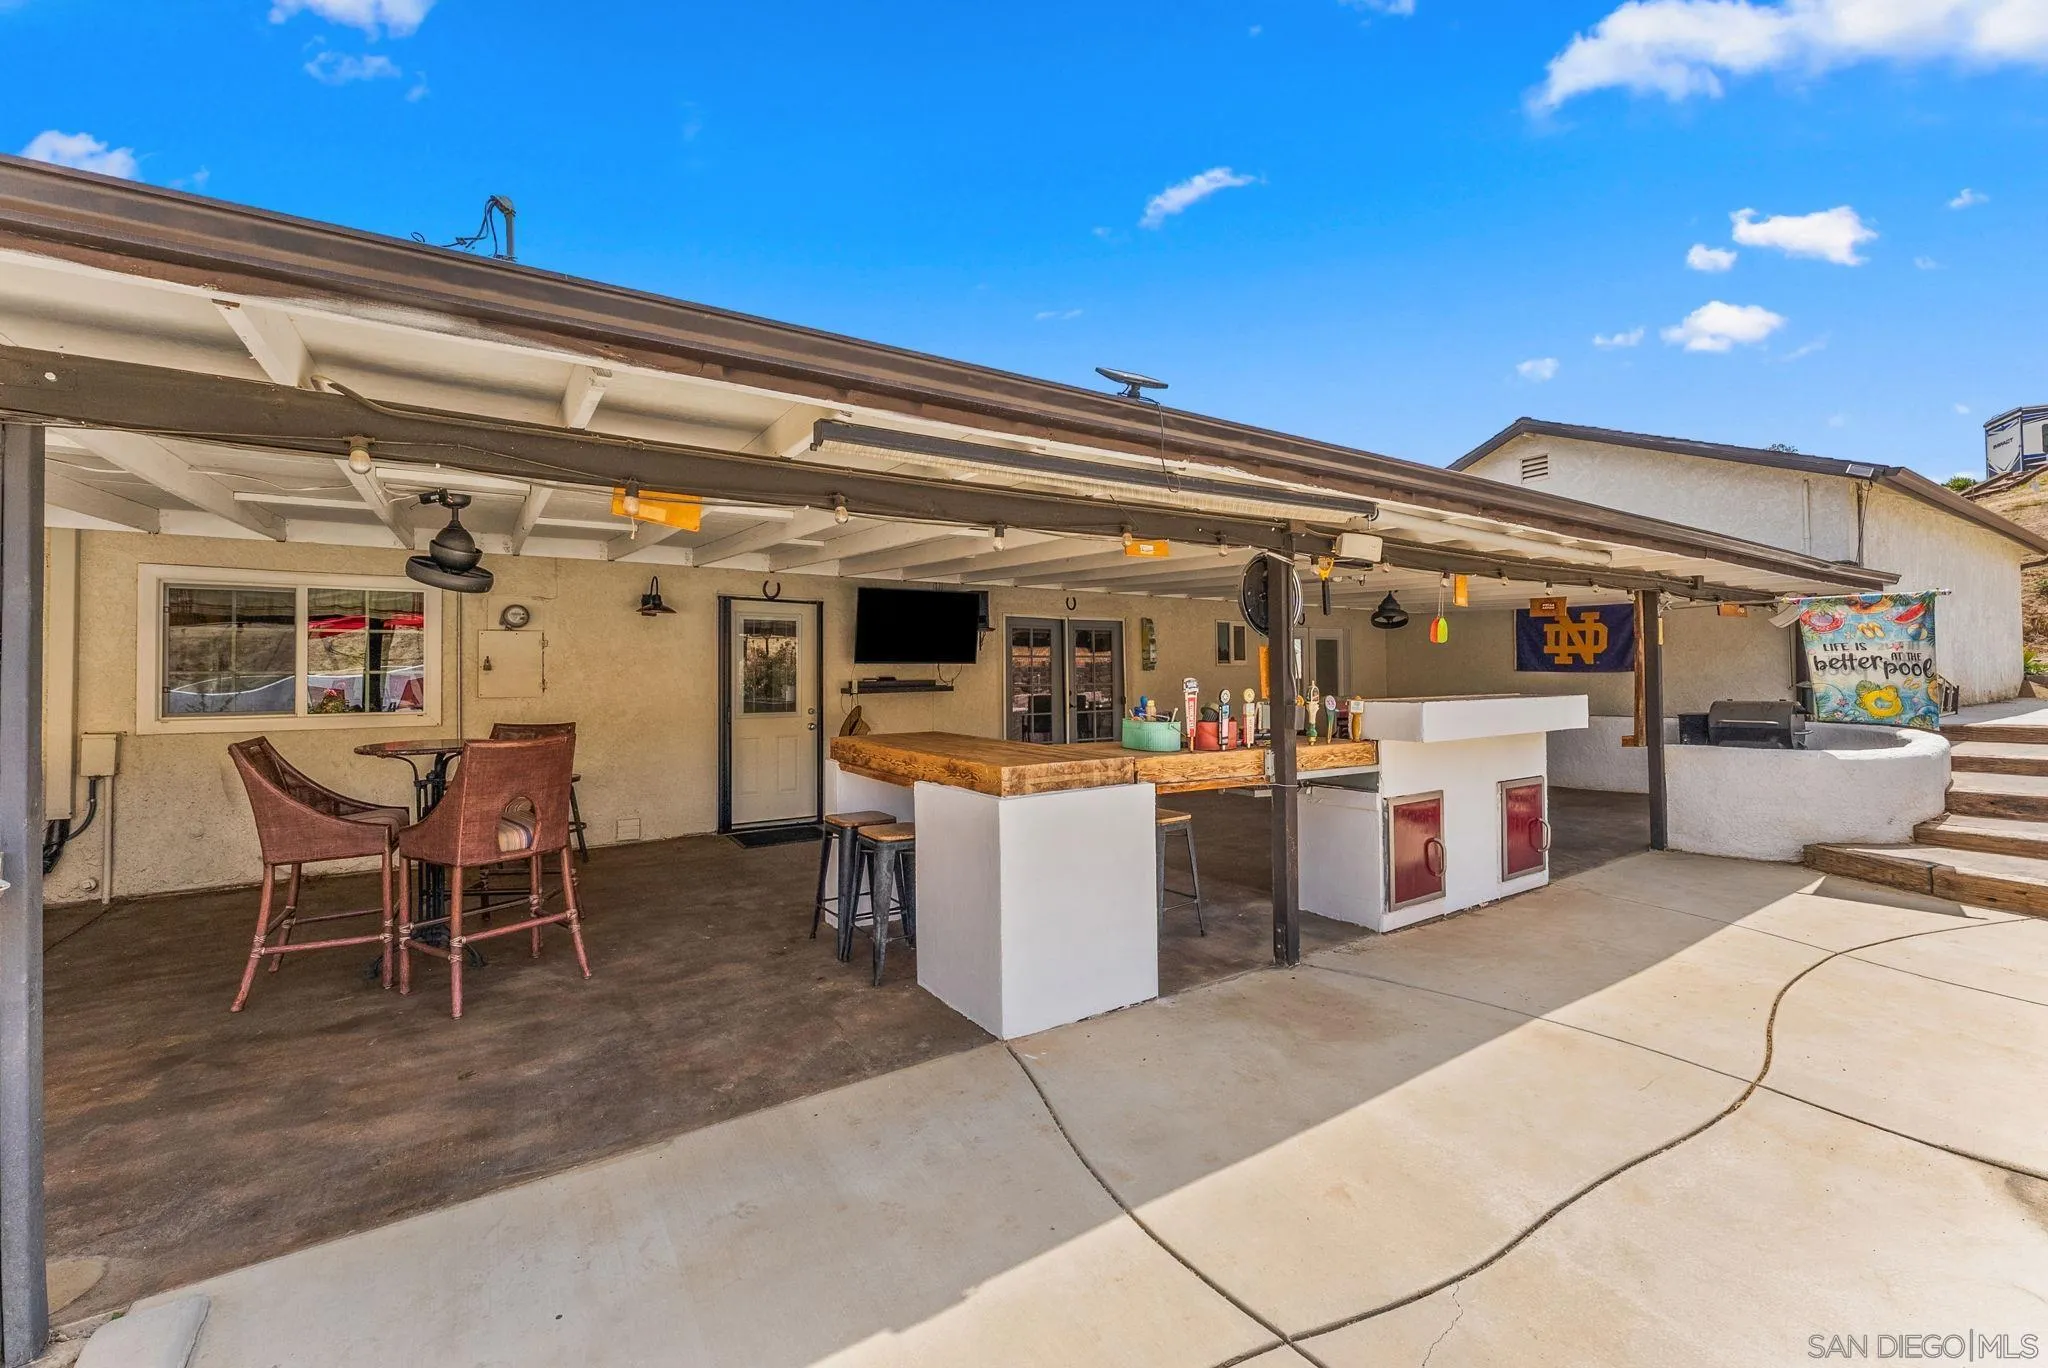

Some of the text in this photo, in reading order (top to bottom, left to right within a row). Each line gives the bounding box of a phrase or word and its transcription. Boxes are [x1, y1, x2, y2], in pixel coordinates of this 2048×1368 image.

[1823, 642, 1867, 651] LIFE IS
[1813, 652, 1882, 672] better
[1890, 652, 1922, 661] AT THE
[1883, 657, 1935, 680] pool
